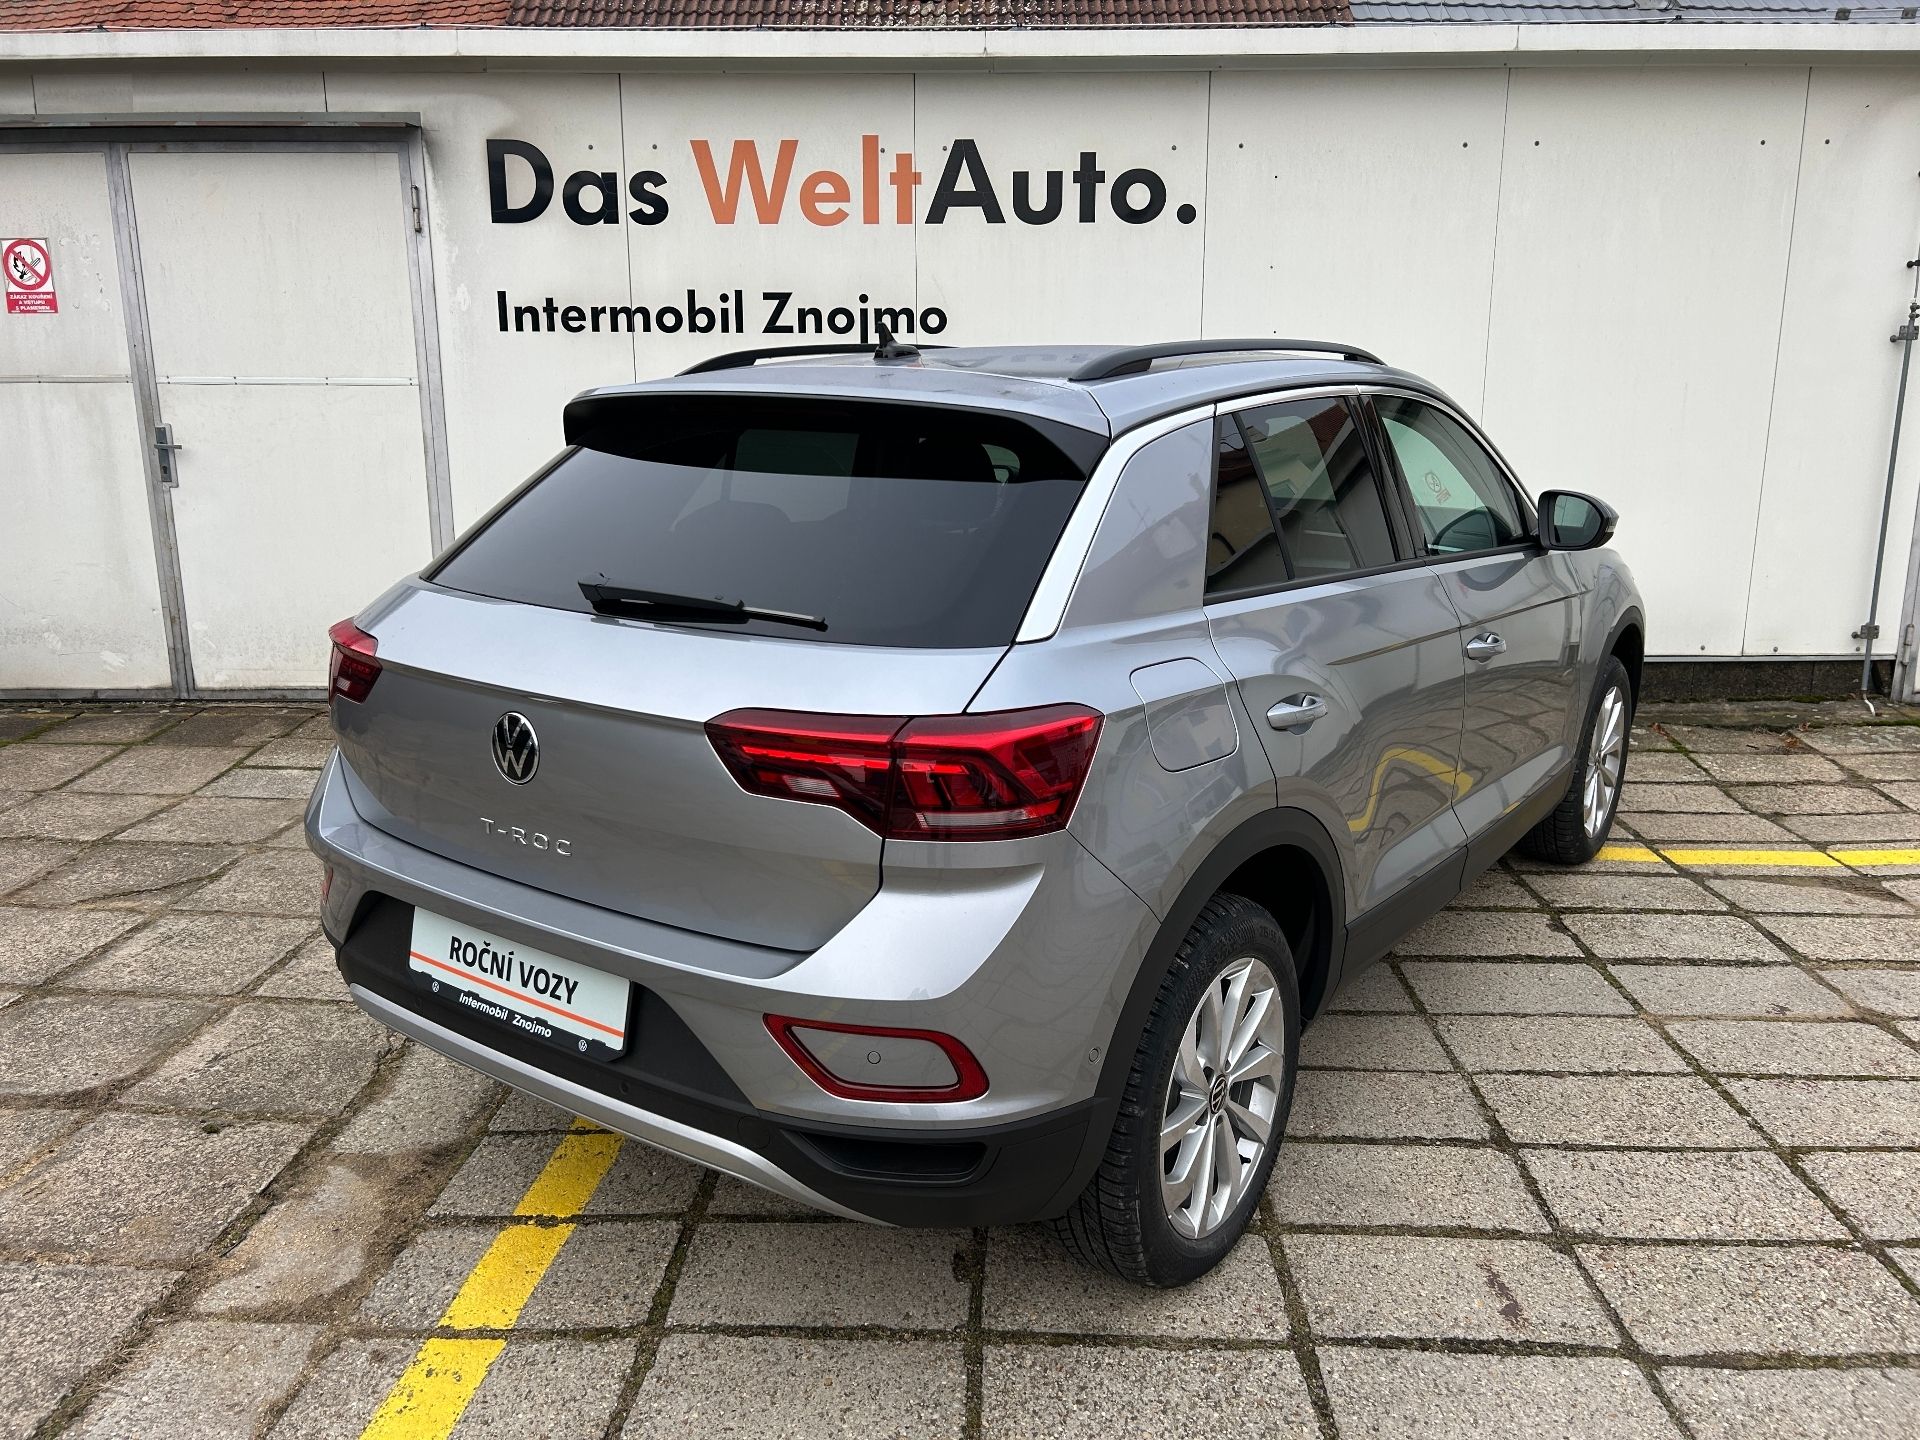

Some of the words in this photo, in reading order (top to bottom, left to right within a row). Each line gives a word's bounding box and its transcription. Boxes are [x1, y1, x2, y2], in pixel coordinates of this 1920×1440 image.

[485, 138, 670, 226] Das
[689, 134, 1198, 228] WeltAuto.
[497, 289, 745, 335] Intermobil
[762, 291, 948, 343] Znojmo
[480, 817, 573, 857] T-ROC
[449, 935, 515, 983] ROČNÍ
[519, 960, 579, 1005] VOZY
[459, 992, 508, 1021] Intermobil
[512, 1014, 552, 1039] Znojmo
